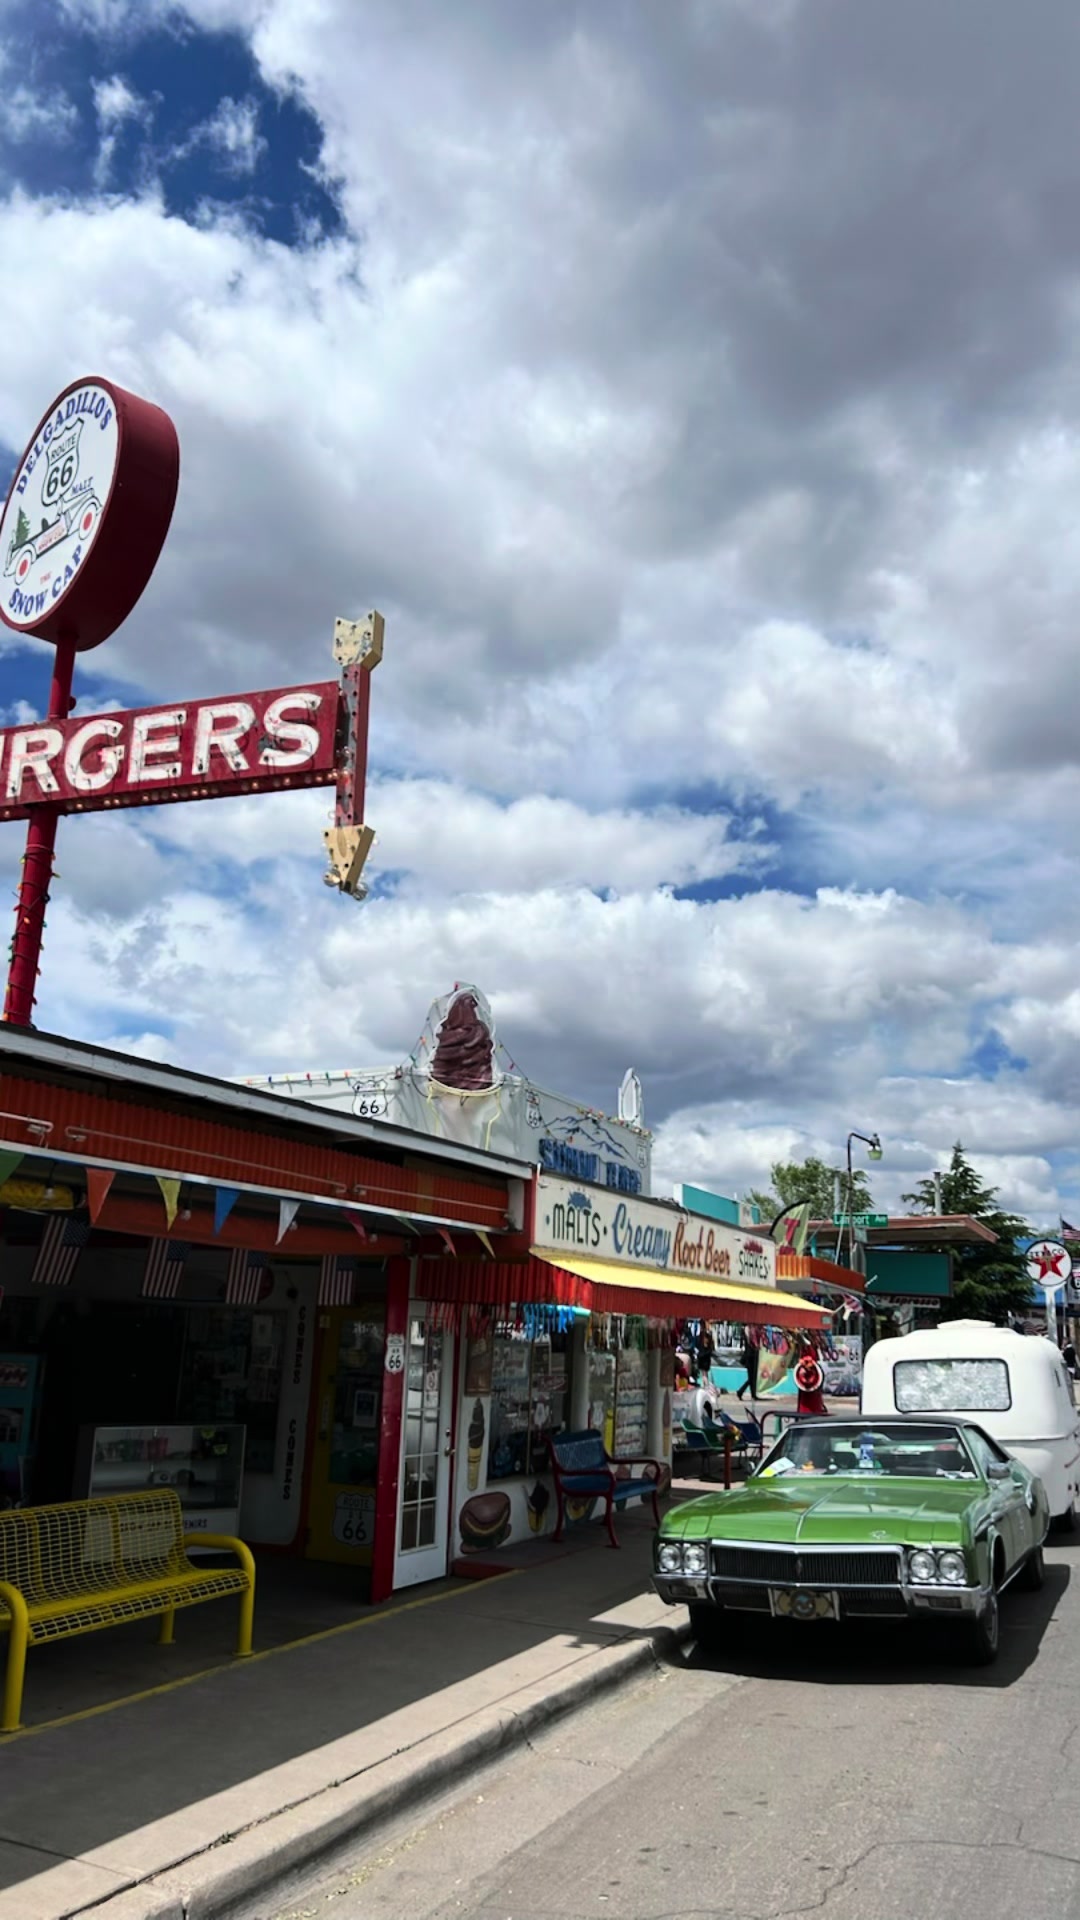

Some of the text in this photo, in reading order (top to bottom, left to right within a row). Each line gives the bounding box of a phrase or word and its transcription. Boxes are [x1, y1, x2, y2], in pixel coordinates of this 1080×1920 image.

[51, 432, 77, 460] ROUTE
[46, 455, 74, 498] 66
[9, 544, 82, 617] SNOW CAP
[0, 692, 322, 799] RGERS
[359, 1100, 380, 1115] 66
[552, 1203, 601, 1247] MALTS
[612, 1203, 671, 1268] Creamy
[672, 1221, 704, 1269] Root
[704, 1228, 730, 1276] Beer
[739, 1250, 769, 1279] SHAKES
[388, 1354, 401, 1369] 66
[343, 1496, 369, 1508] ROUTE
[343, 1520, 367, 1541] 66
